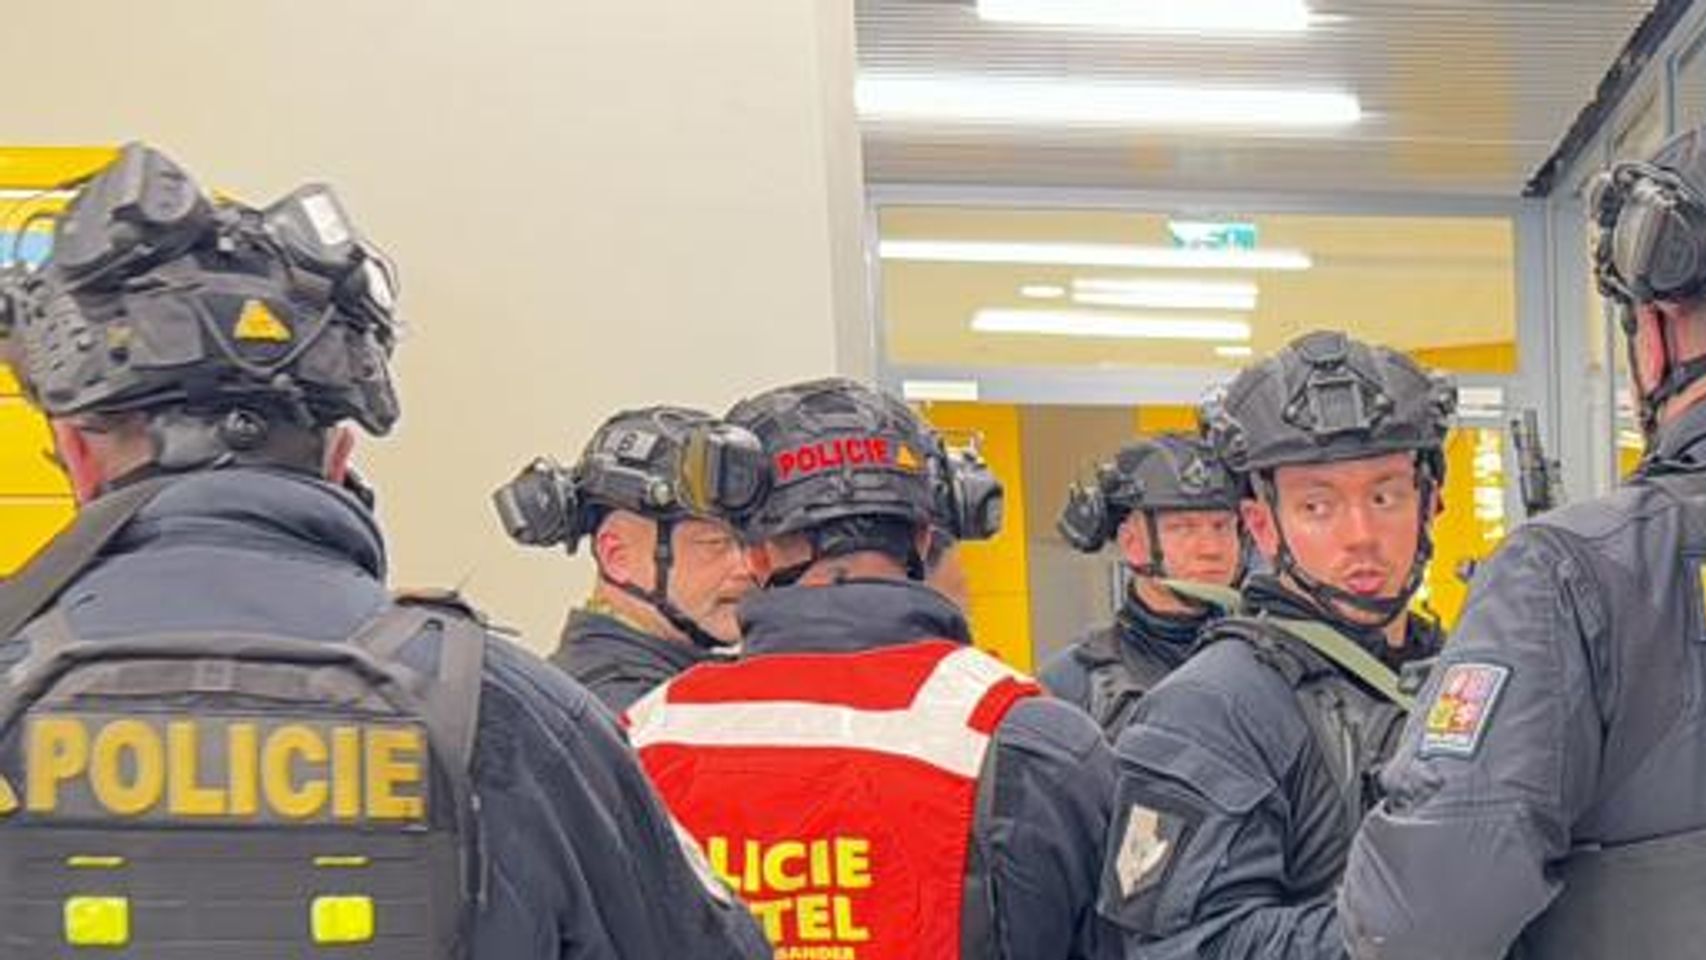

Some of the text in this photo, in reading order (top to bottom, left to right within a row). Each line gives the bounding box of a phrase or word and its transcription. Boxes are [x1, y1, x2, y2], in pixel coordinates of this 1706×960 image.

[775, 438, 888, 481] POLICIE
[26, 718, 427, 820] POLICIE
[707, 836, 872, 892] LICIE
